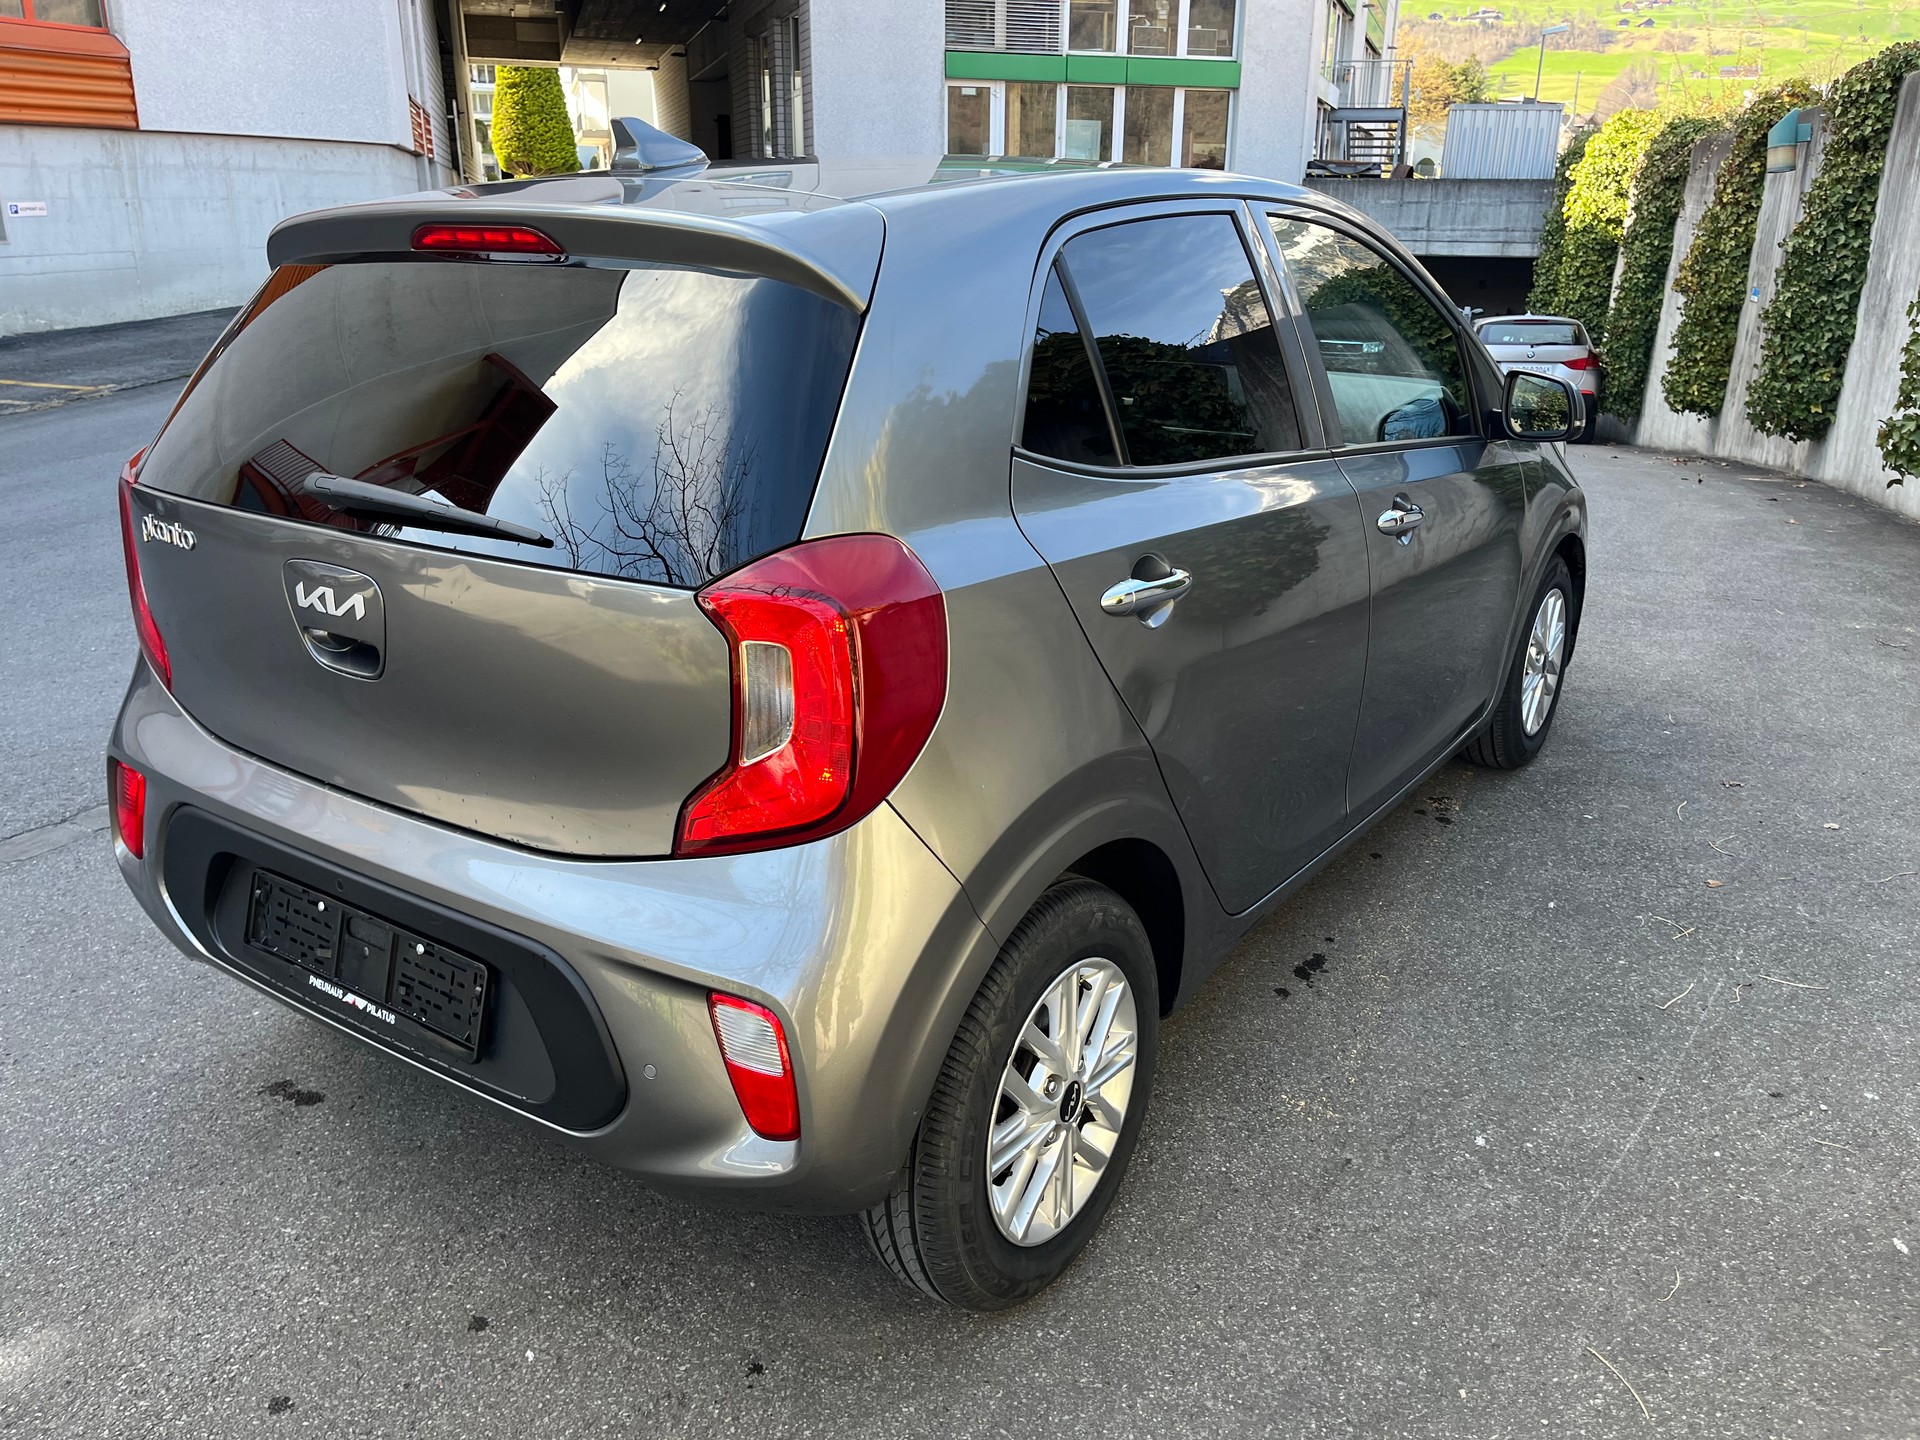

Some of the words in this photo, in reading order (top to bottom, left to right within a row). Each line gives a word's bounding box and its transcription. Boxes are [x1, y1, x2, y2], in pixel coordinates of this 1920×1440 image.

[141, 513, 196, 551] picanto
[295, 581, 366, 621] KIA
[308, 974, 344, 1000] PNEUHAUS
[366, 1002, 396, 1025] PILATUS
